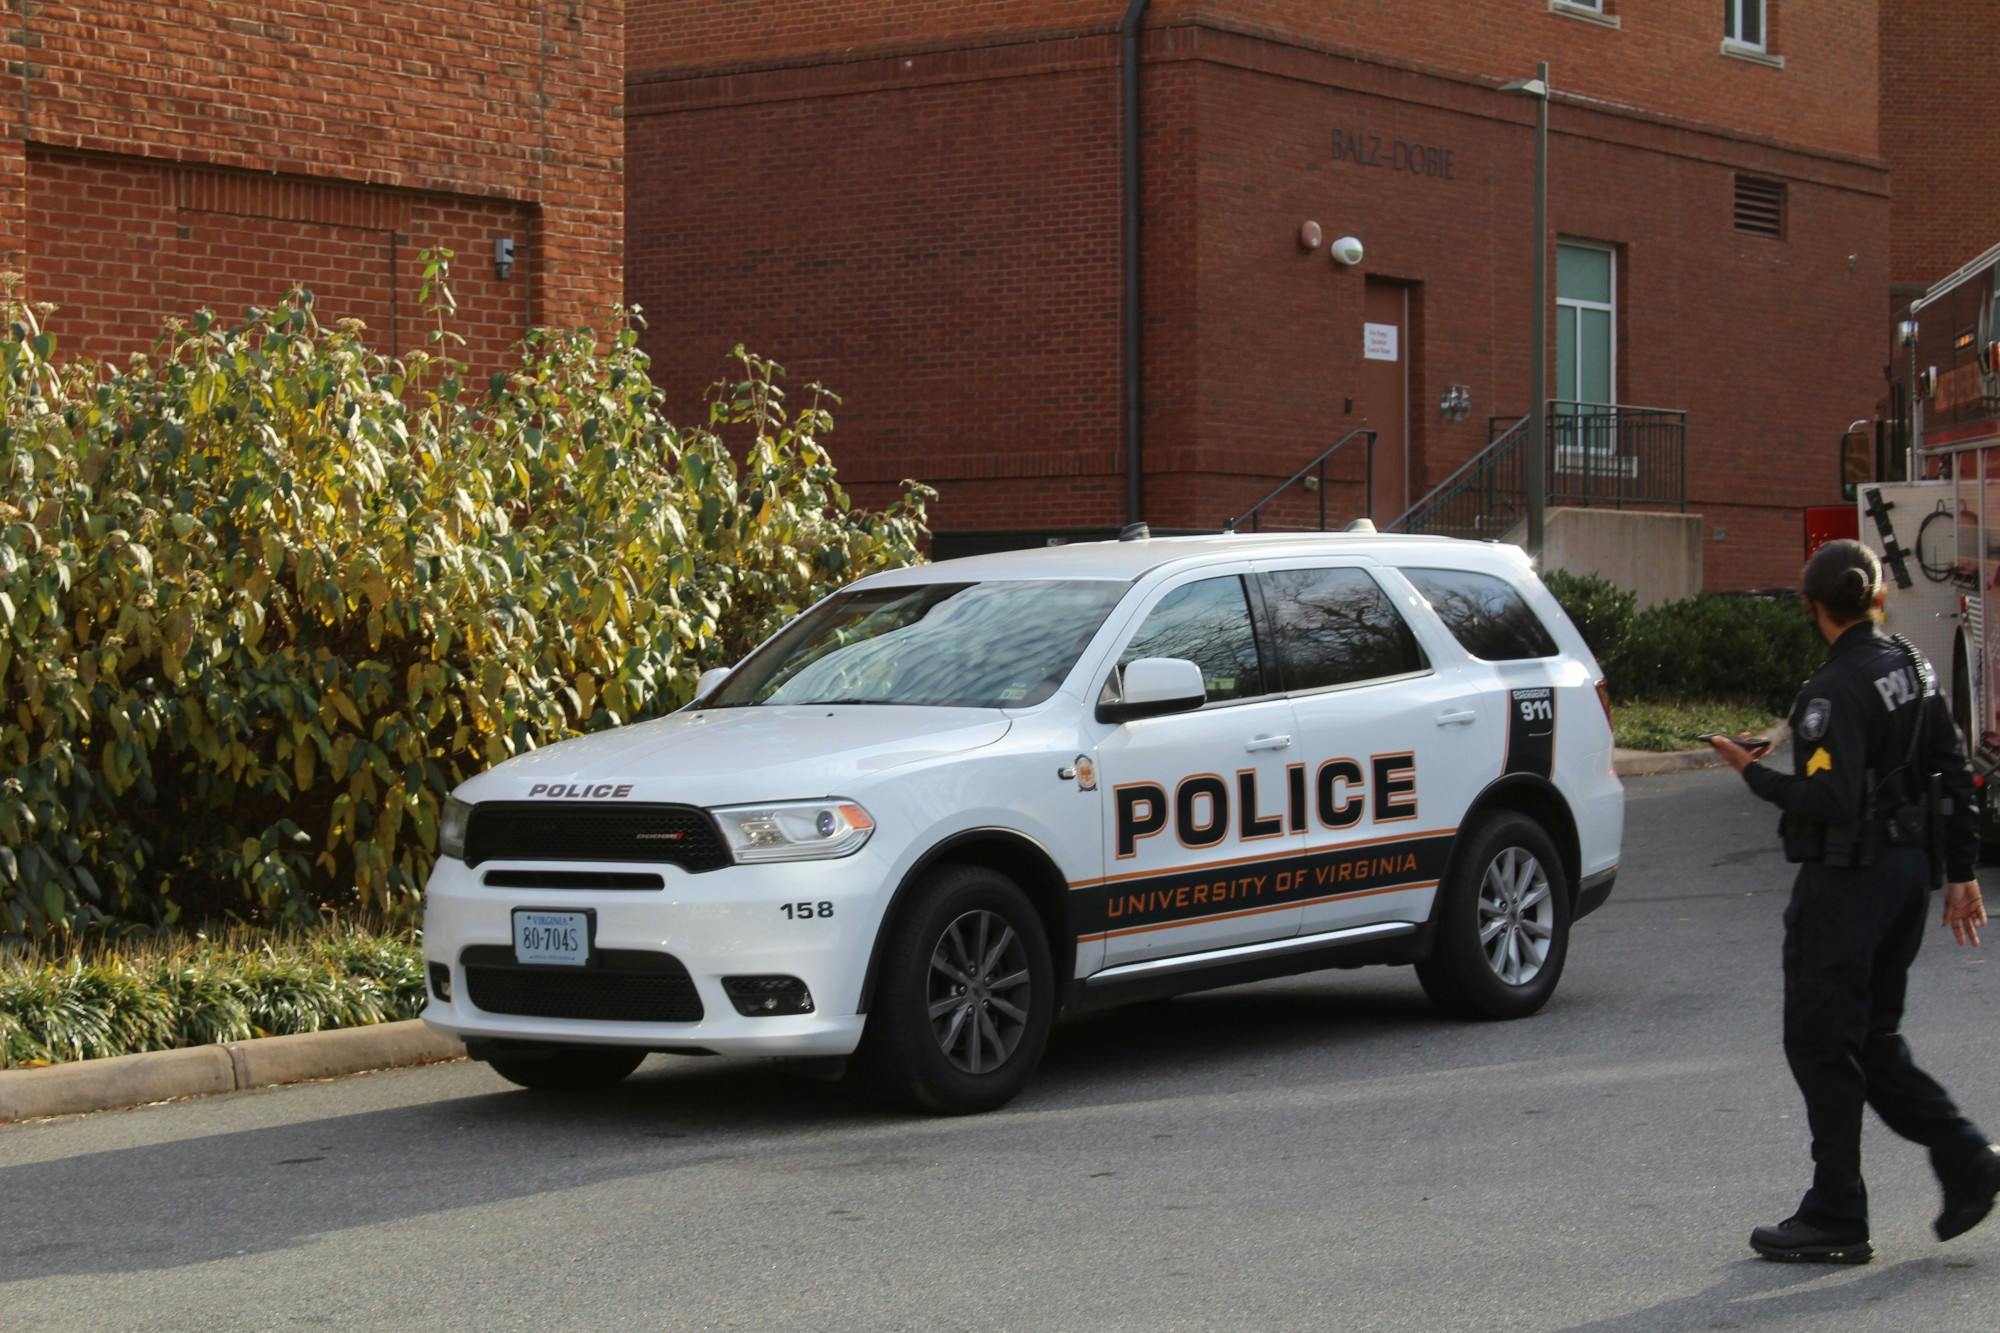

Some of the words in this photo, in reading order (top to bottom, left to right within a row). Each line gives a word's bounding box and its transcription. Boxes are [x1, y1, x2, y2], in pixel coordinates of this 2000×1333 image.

[1332, 128, 1455, 179] BALZ-DOBIE
[1520, 700, 1553, 721] 911
[528, 783, 634, 798] POLICE
[1113, 750, 1418, 860] POLICE
[1107, 876, 1267, 917] UNIVERSITY
[1275, 869, 1309, 892] OF
[1316, 853, 1417, 886] VIRGINIA
[780, 901, 834, 920] 158
[523, 927, 578, 951] 80-704S
